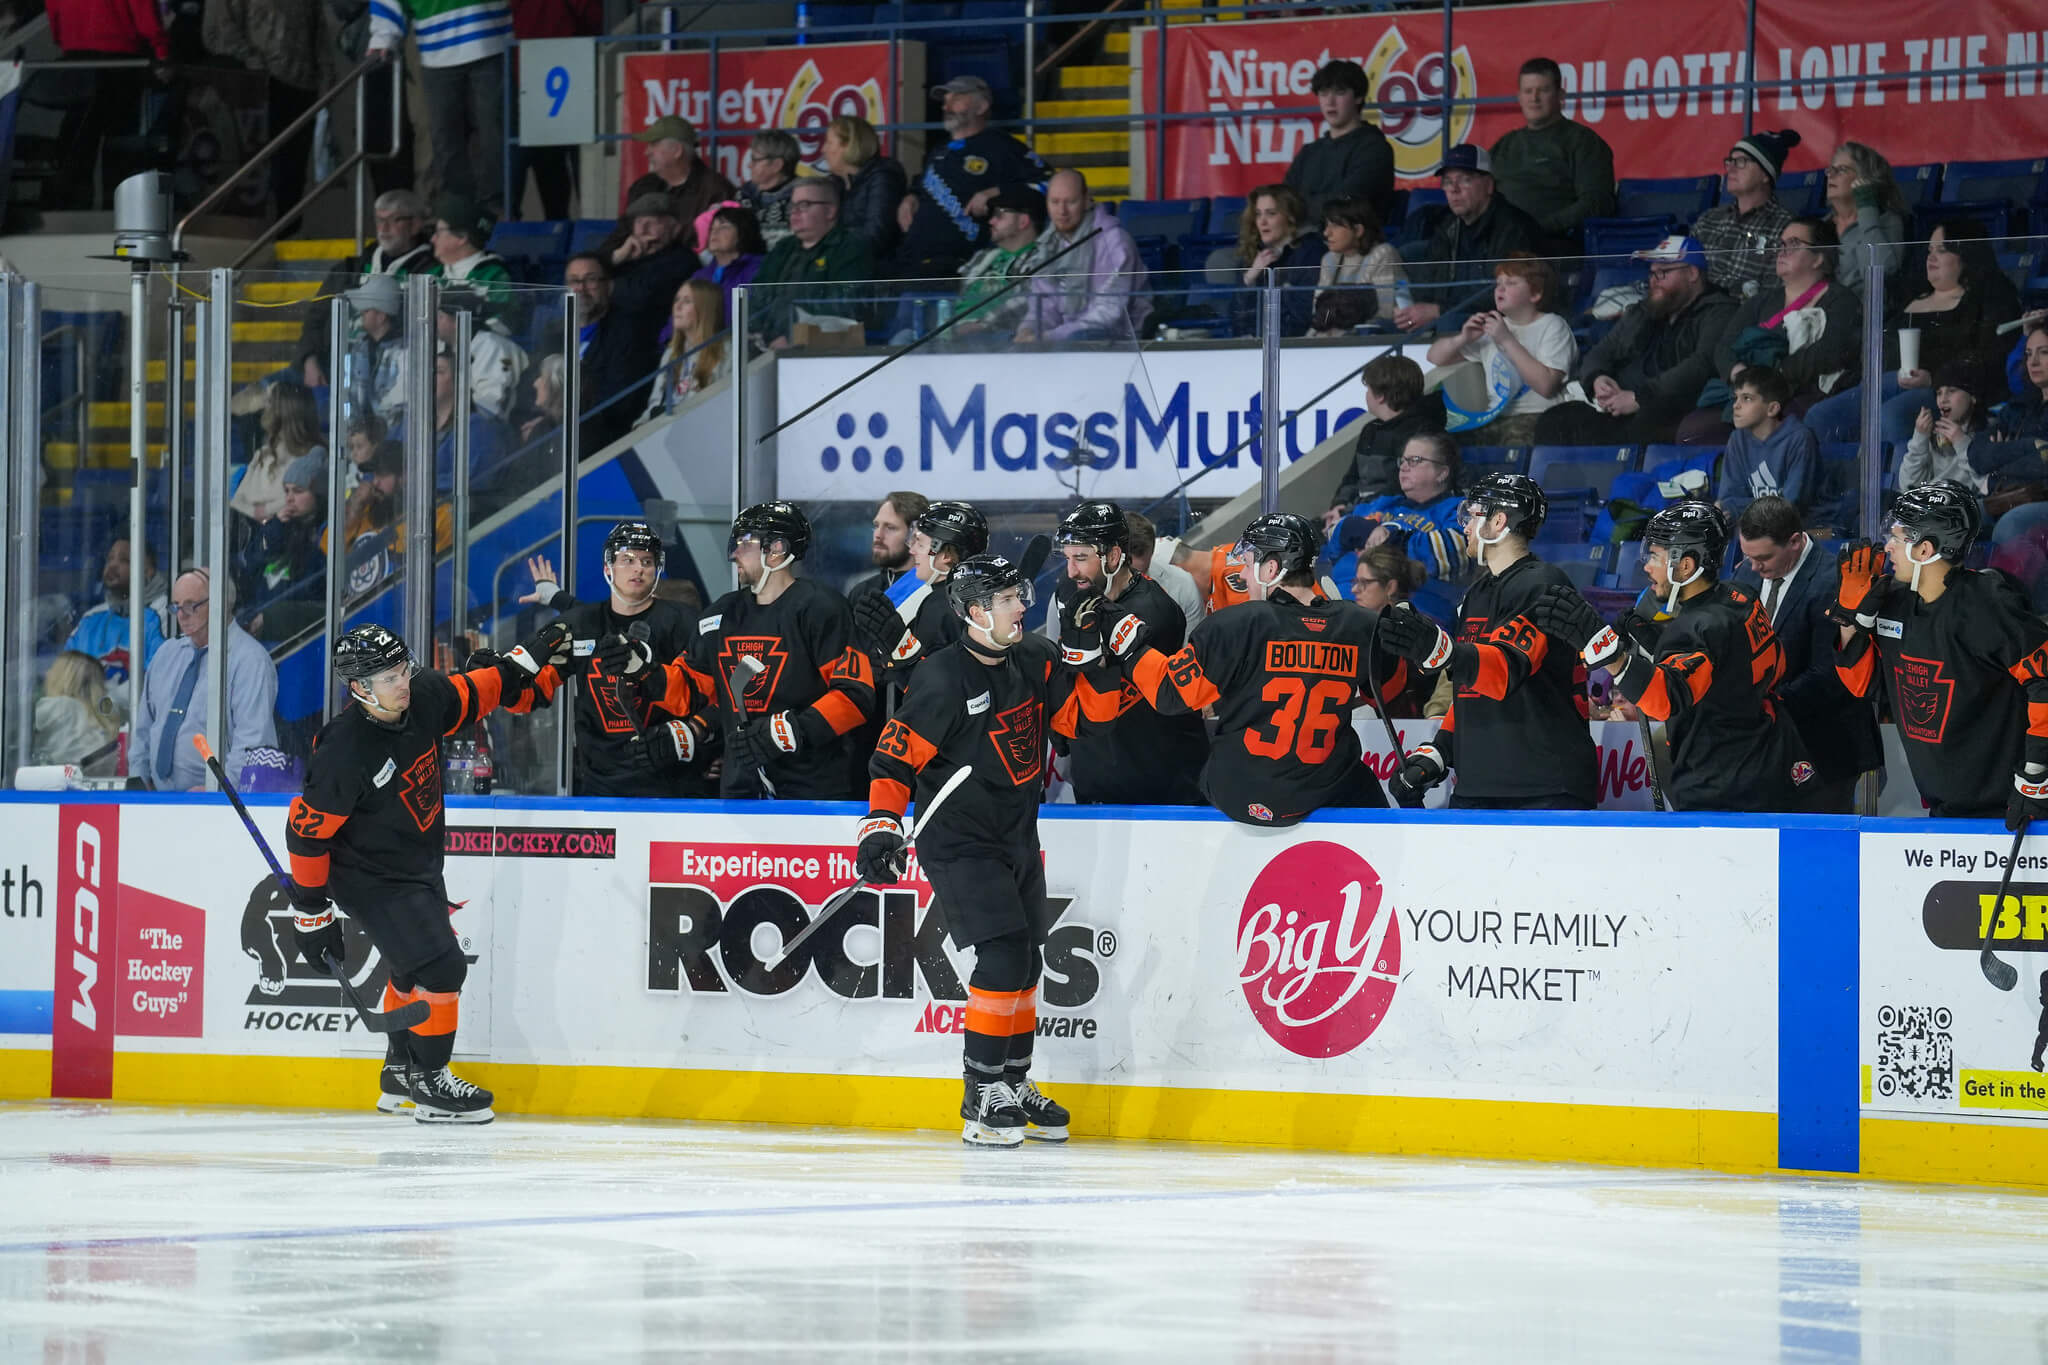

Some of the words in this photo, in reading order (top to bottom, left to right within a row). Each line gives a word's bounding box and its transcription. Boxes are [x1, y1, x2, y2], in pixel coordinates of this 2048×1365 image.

[1208, 48, 1363, 98] Nine
[1559, 60, 1607, 124] OU
[1623, 50, 1761, 121] GOTTA
[1777, 42, 1888, 111] LOVE
[1903, 35, 1988, 104] THE
[545, 66, 569, 118] 9
[644, 78, 784, 130] Ninety
[1208, 100, 1330, 165] Nin
[948, 513, 962, 523] ppl
[1268, 518, 1282, 526] ppl
[736, 642, 764, 652] LEHIGH
[1499, 616, 1537, 652] 56
[1168, 647, 1202, 688] 36
[1270, 644, 1353, 673] BOULTON
[1905, 663, 1929, 675] LEHIGH
[1906, 674, 1929, 688] VALLEY
[1243, 677, 1352, 764] 36
[670, 720, 690, 759] CCM
[877, 721, 912, 757] 25
[292, 803, 325, 837] 22
[445, 832, 615, 855] DKHOCKEY.COM
[682, 849, 820, 883] Experience
[1904, 849, 1934, 868] We
[1940, 849, 1978, 873] Play
[71, 821, 101, 1032] CCM
[1406, 908, 1503, 945] YOUR
[1514, 911, 1628, 948] FAMILY
[127, 959, 193, 988] Hockey
[244, 1011, 361, 1033] HOCKEY
[914, 1000, 966, 1035] ACE
[1965, 1079, 1996, 1097] Get
[2000, 1081, 2015, 1098] in
[2019, 1081, 2047, 1099] the
